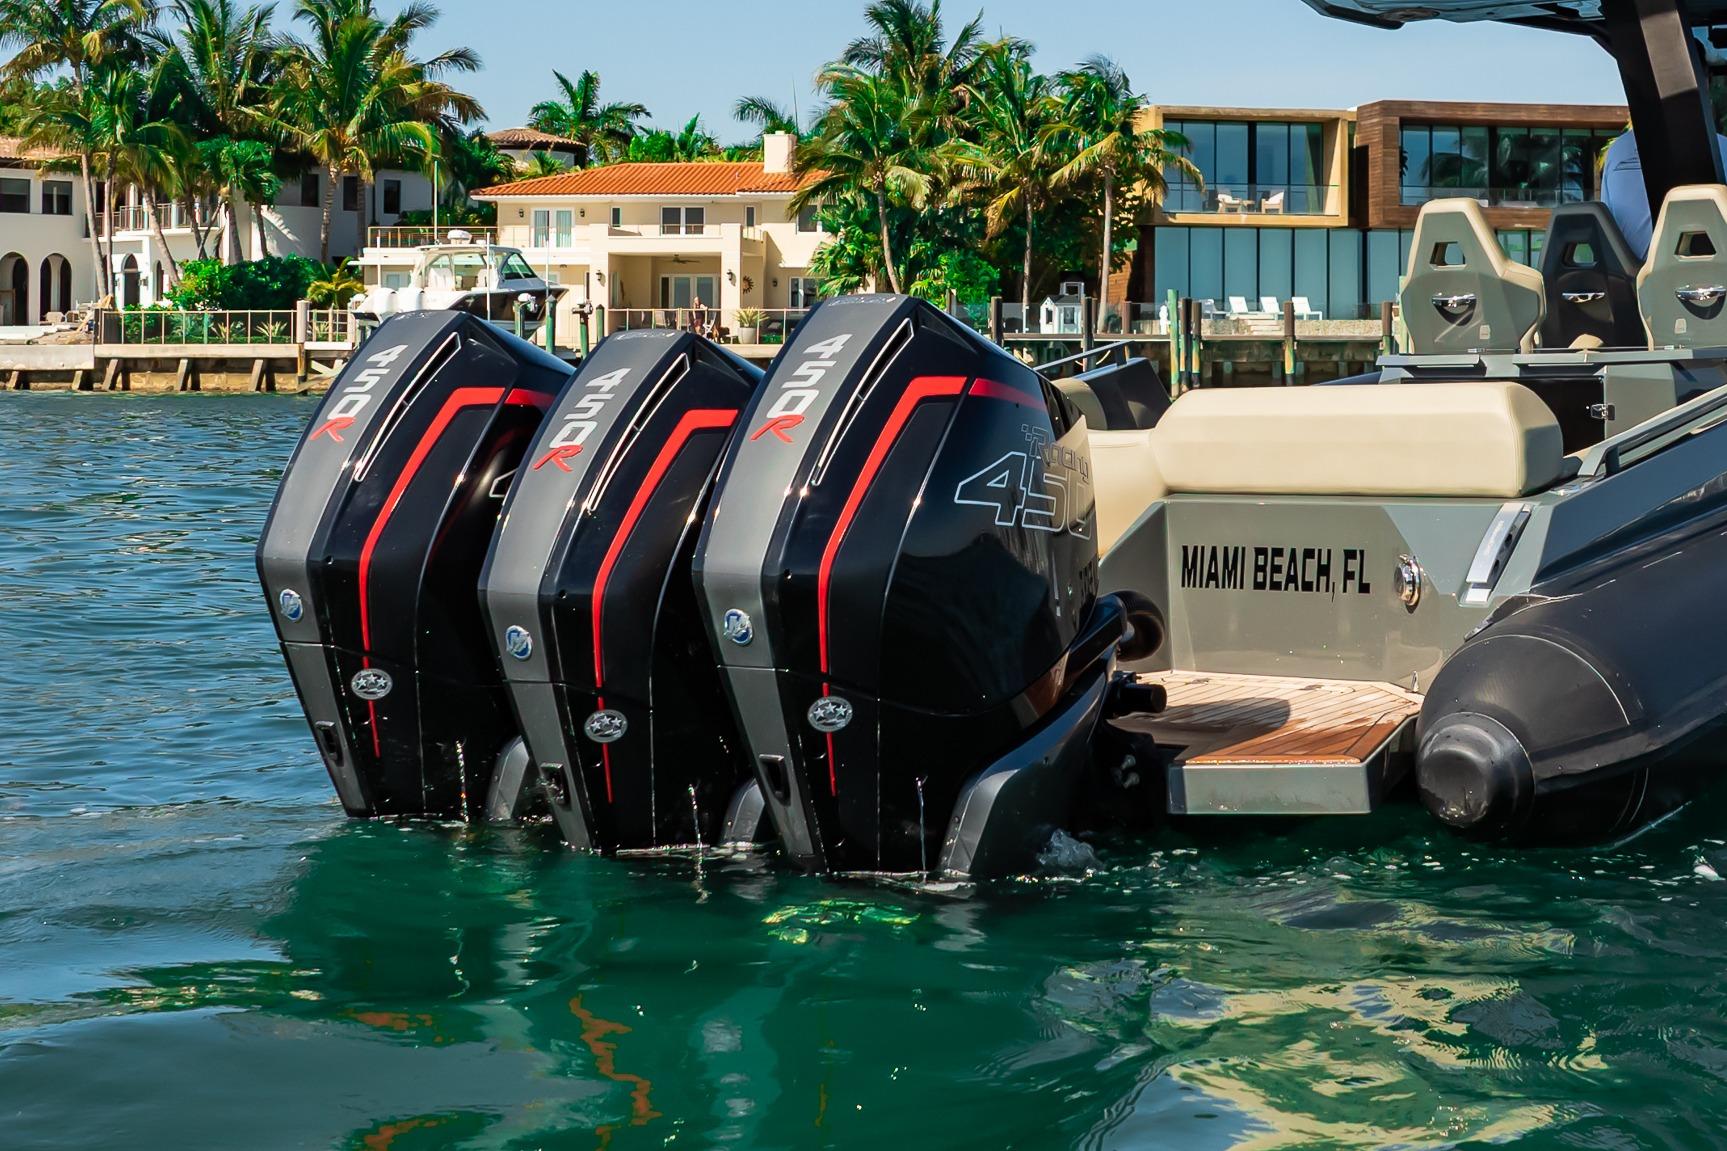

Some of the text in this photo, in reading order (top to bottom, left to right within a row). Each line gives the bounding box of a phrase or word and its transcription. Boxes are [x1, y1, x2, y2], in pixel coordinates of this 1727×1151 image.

[954, 451, 1096, 541] 450
[1181, 545, 1371, 602] MIAMI BEACH, FL
